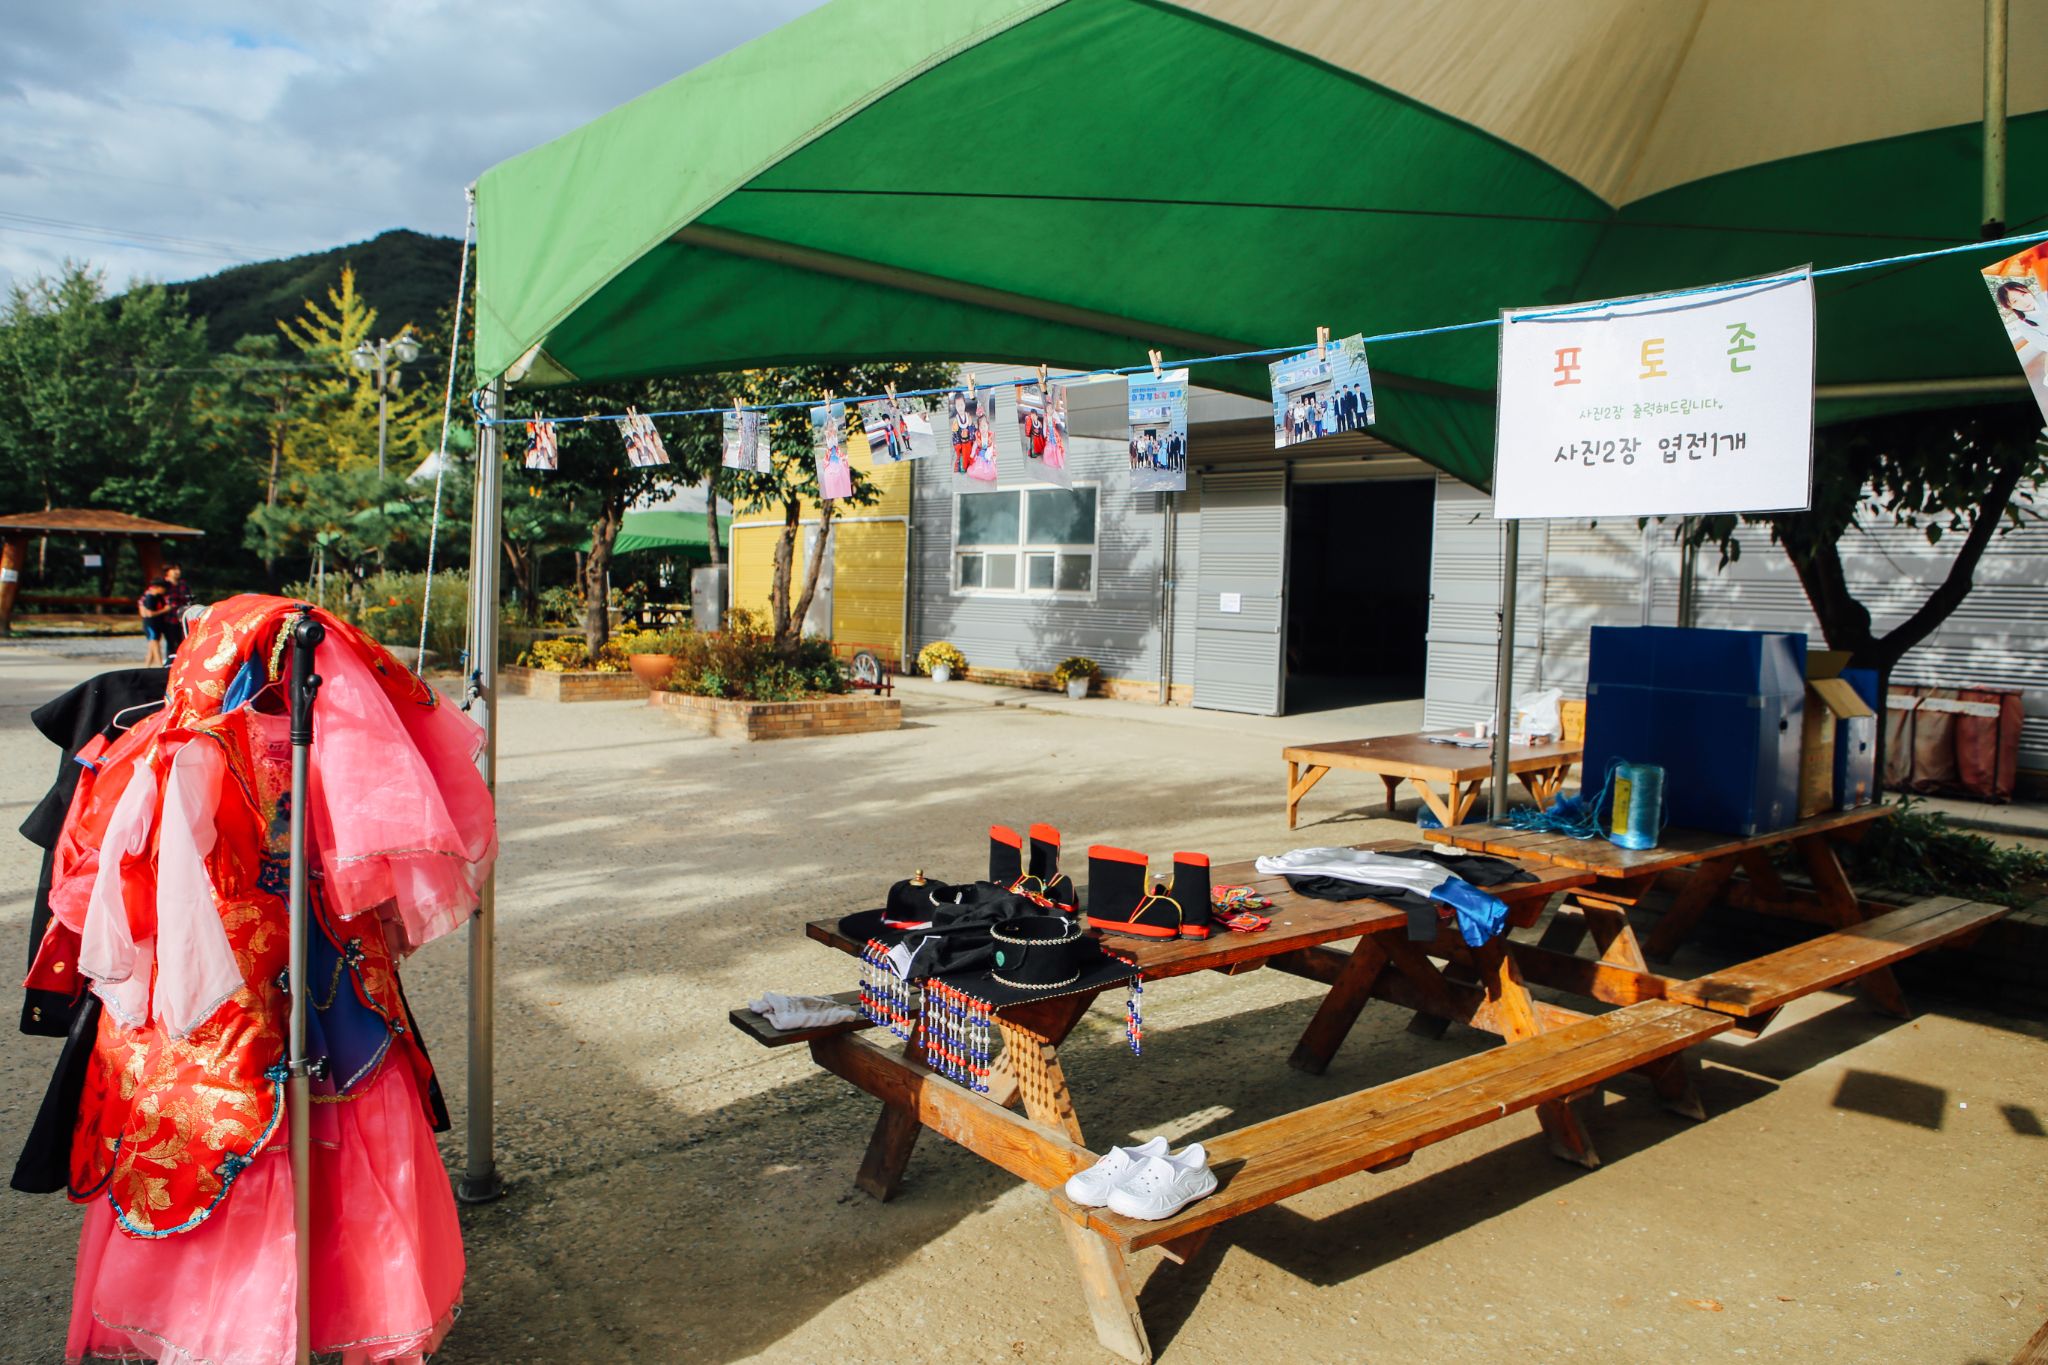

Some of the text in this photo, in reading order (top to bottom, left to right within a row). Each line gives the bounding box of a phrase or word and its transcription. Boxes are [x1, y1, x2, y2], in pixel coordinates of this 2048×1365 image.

[1580, 407, 1624, 421] 사진2장
[1554, 432, 1746, 466] 사진2장 엽전1개
